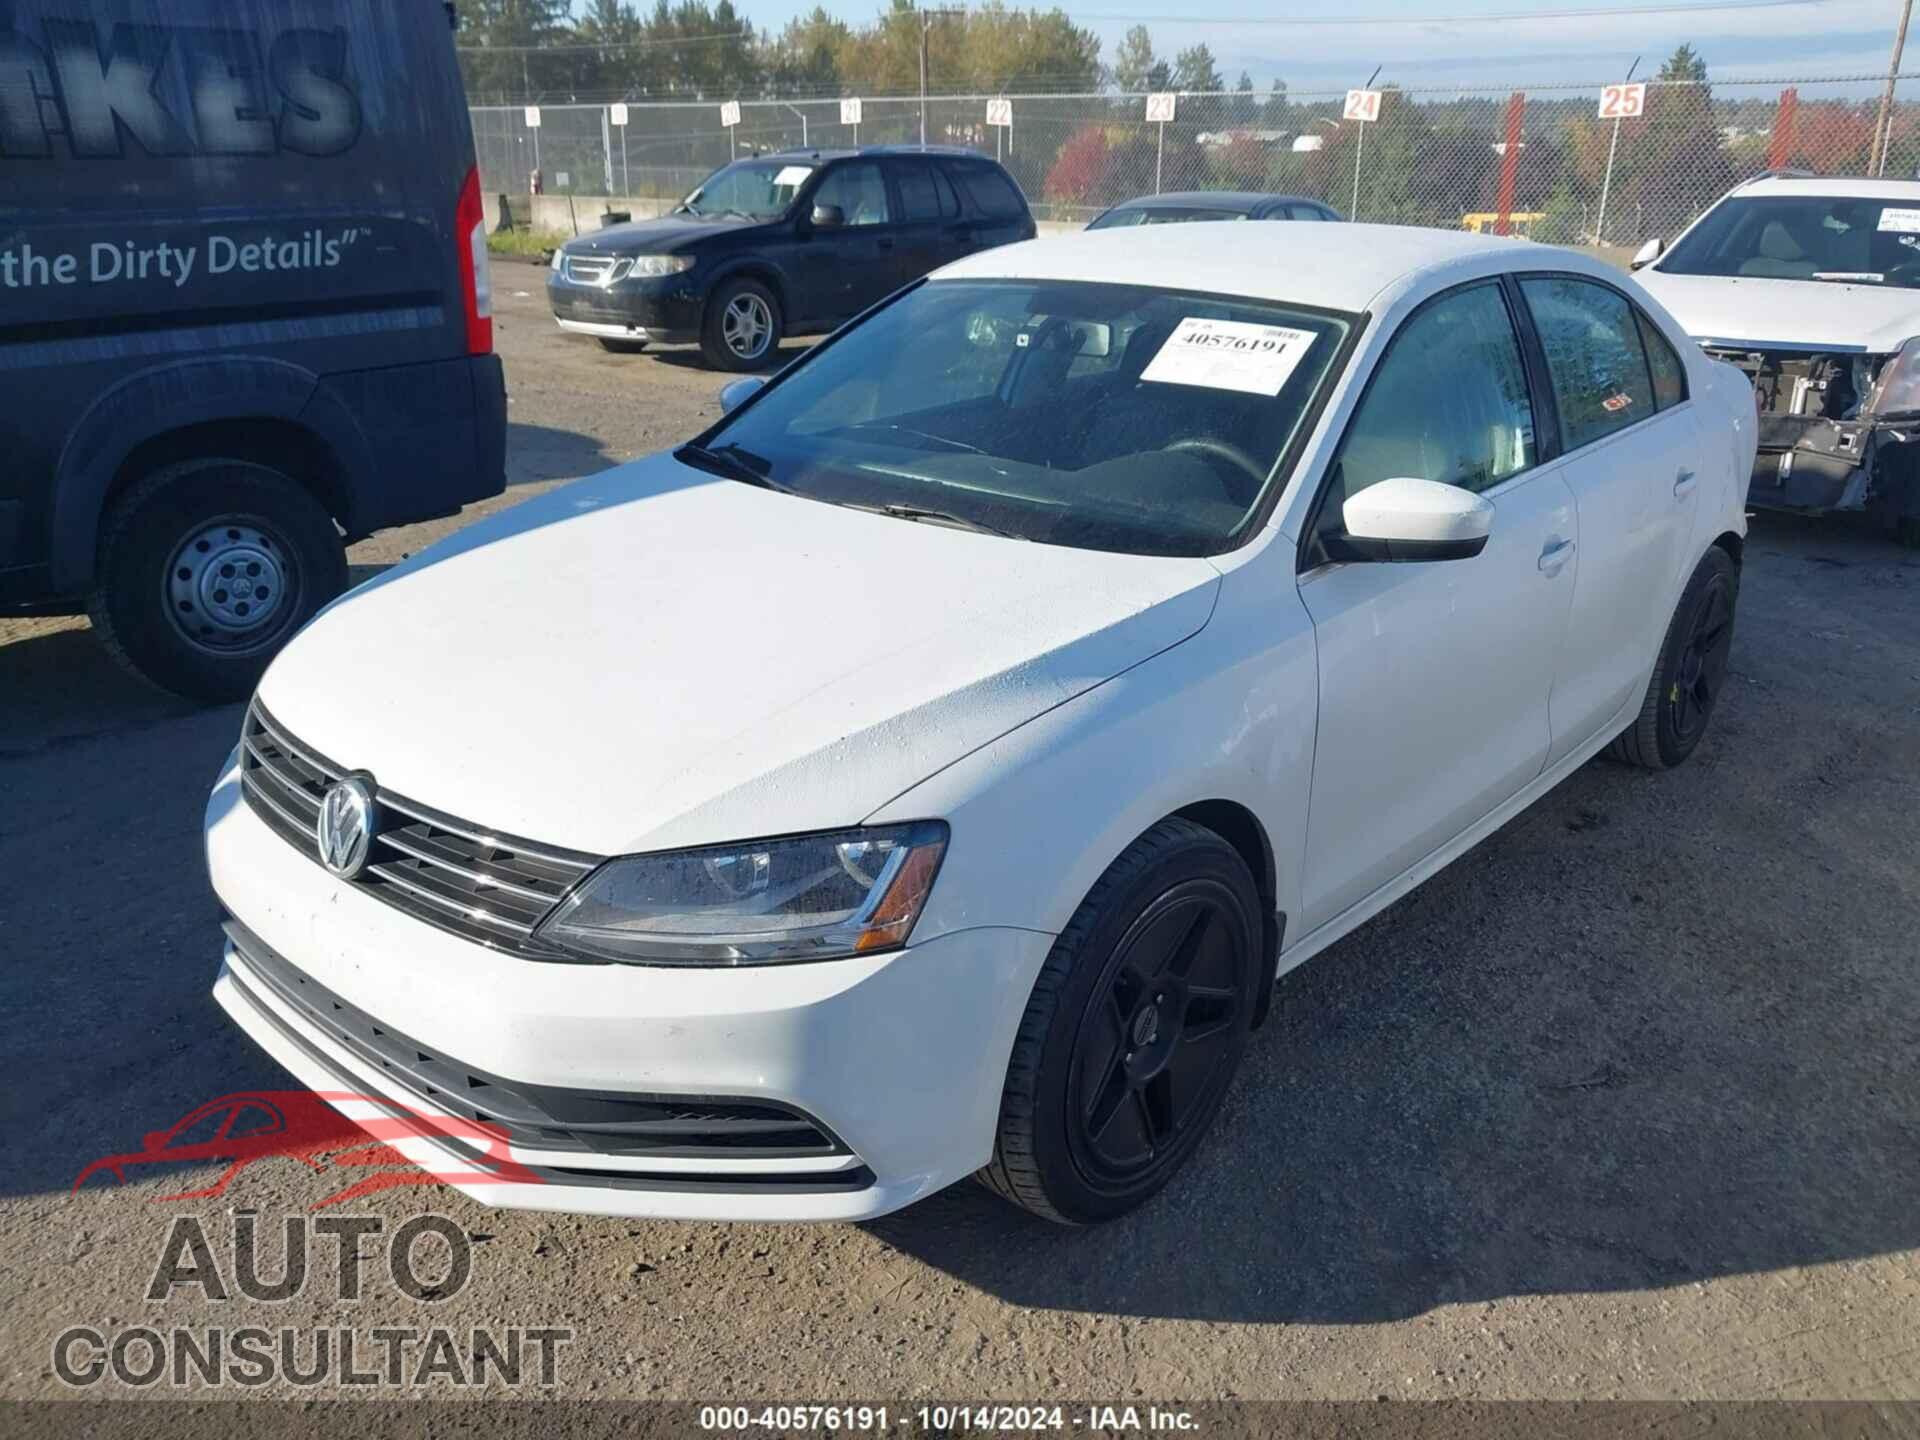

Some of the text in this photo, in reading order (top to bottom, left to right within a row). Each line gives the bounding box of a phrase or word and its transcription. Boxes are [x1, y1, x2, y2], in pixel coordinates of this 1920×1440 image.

[990, 102, 1008, 122] 22
[1150, 96, 1171, 119] 23
[1347, 92, 1376, 117] 24
[1603, 87, 1639, 115] 25
[0, 244, 77, 287] the
[90, 240, 196, 287] Dirty
[1183, 332, 1287, 354] 40576191
